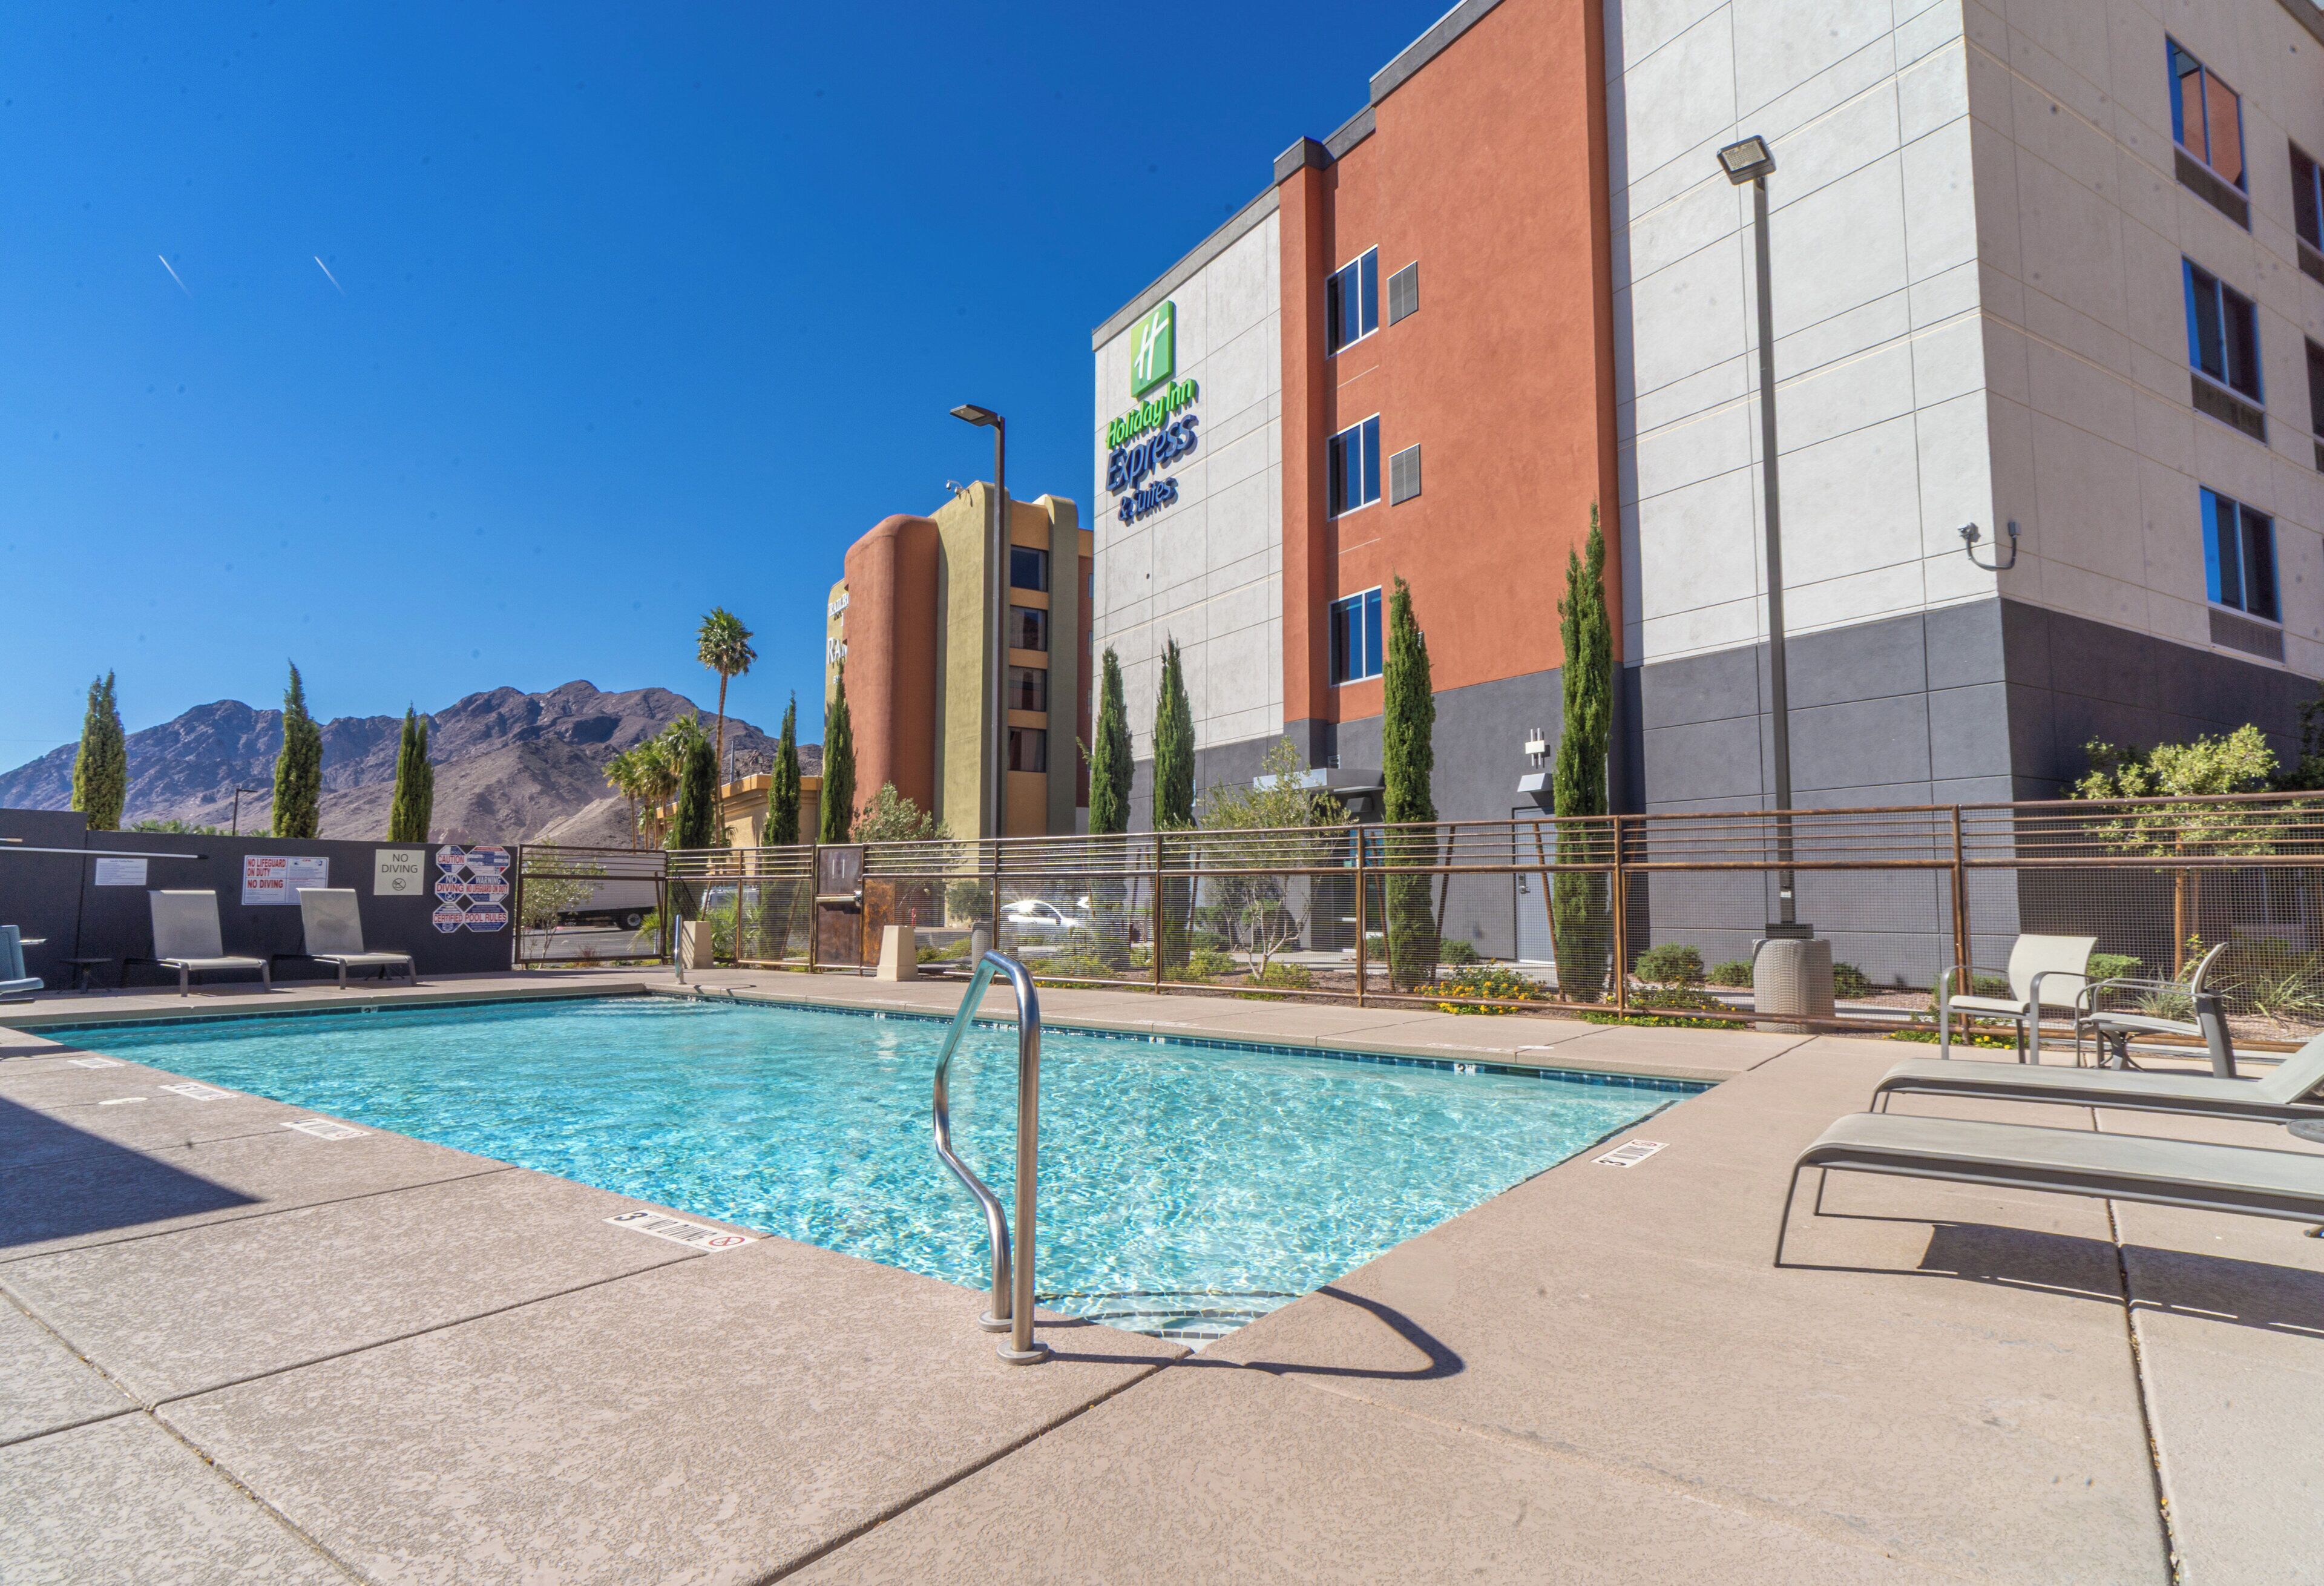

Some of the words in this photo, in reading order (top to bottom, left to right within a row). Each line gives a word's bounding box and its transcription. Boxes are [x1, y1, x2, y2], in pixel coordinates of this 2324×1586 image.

[1106, 395, 1169, 449] Holiday
[1166, 378, 1196, 412] Inn
[1105, 414, 1199, 492] Express
[1118, 496, 1132, 522] &
[247, 858, 255, 867] NO
[257, 859, 286, 867] LIFEGUARD
[392, 854, 409, 862] NO
[247, 868, 255, 877] ON
[256, 868, 271, 877] DUTY
[381, 864, 418, 873] DIVING
[247, 880, 257, 888] NO
[259, 880, 284, 889] DIVING
[475, 876, 501, 884] WARNING
[436, 884, 464, 892] DIVING
[433, 914, 464, 923] CERTIFIED
[465, 913, 484, 922] POOL
[614, 1212, 648, 1222] 3
